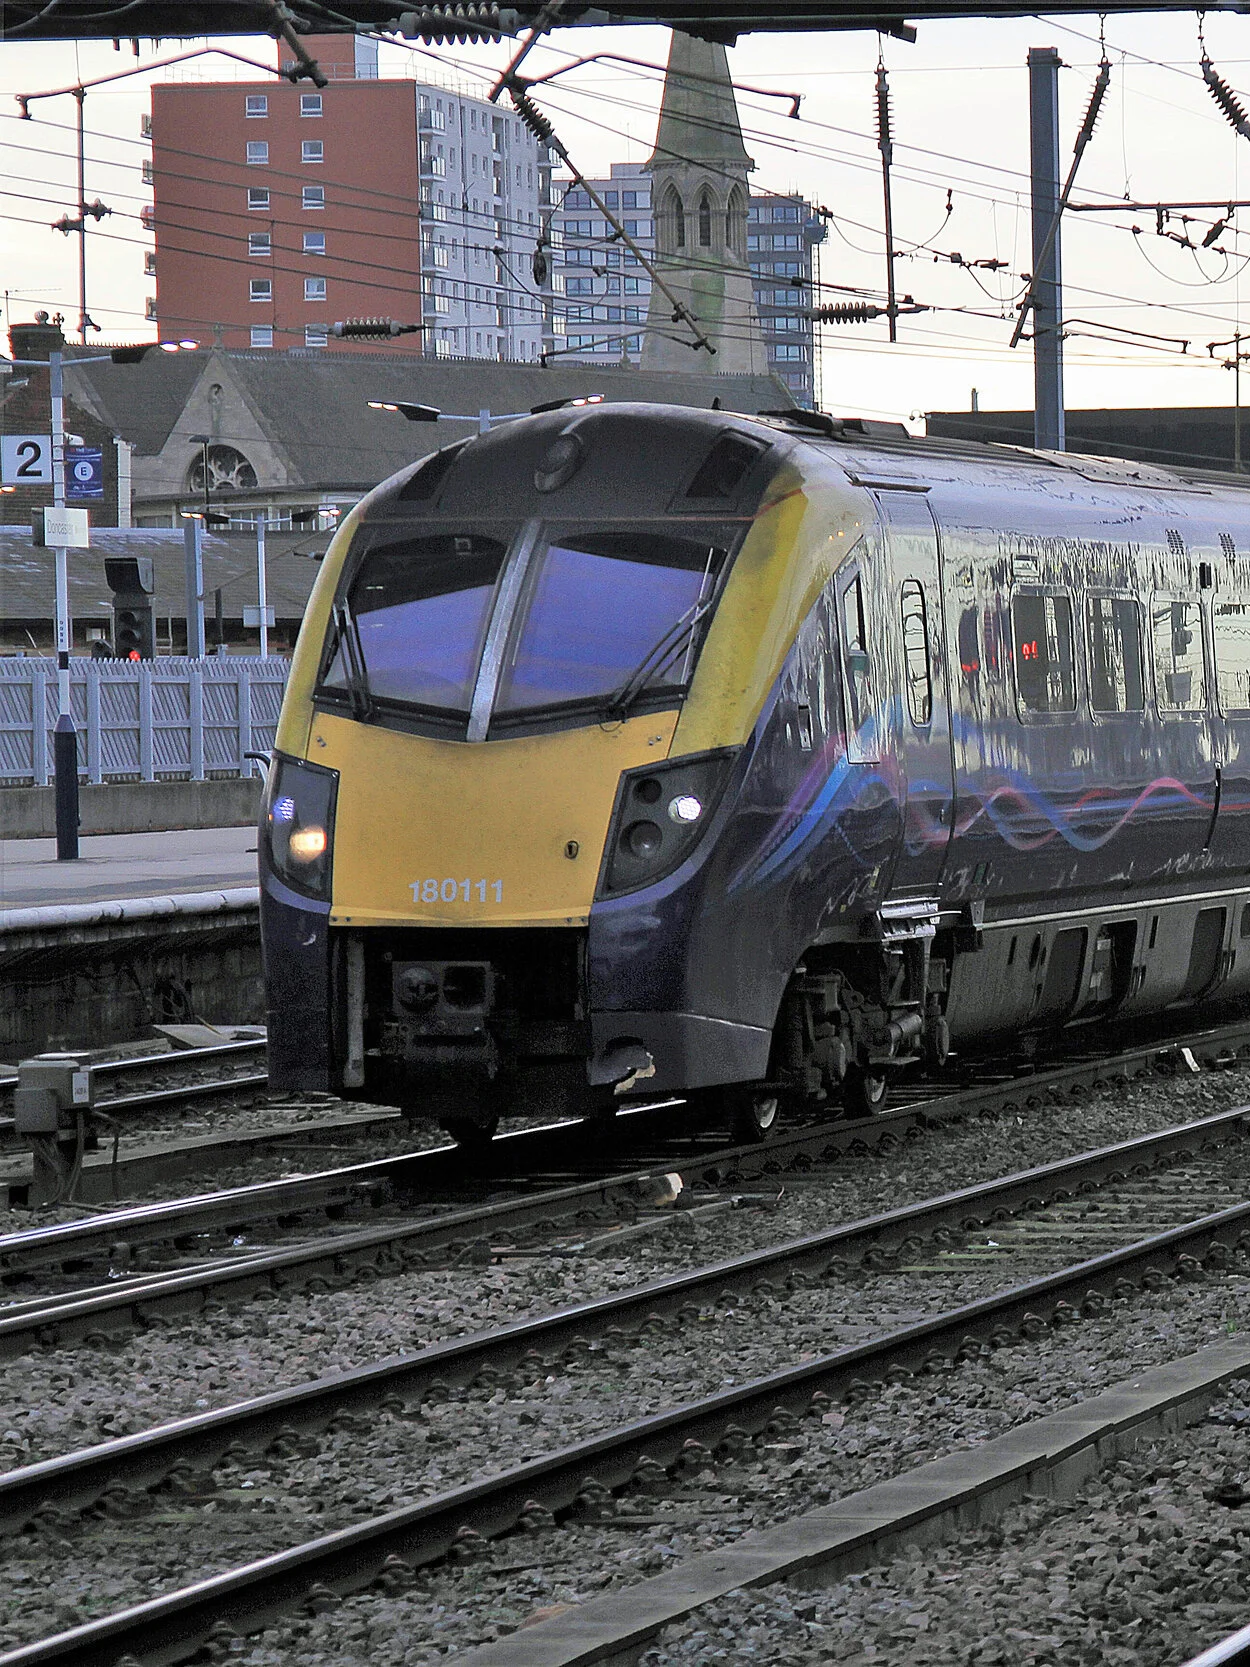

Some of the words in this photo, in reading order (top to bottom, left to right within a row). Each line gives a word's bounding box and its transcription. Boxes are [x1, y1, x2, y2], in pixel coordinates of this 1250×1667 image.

[16, 440, 42, 477] 2
[80, 466, 88, 476] E
[47, 519, 74, 535] Doncas
[408, 878, 503, 903] 180111
